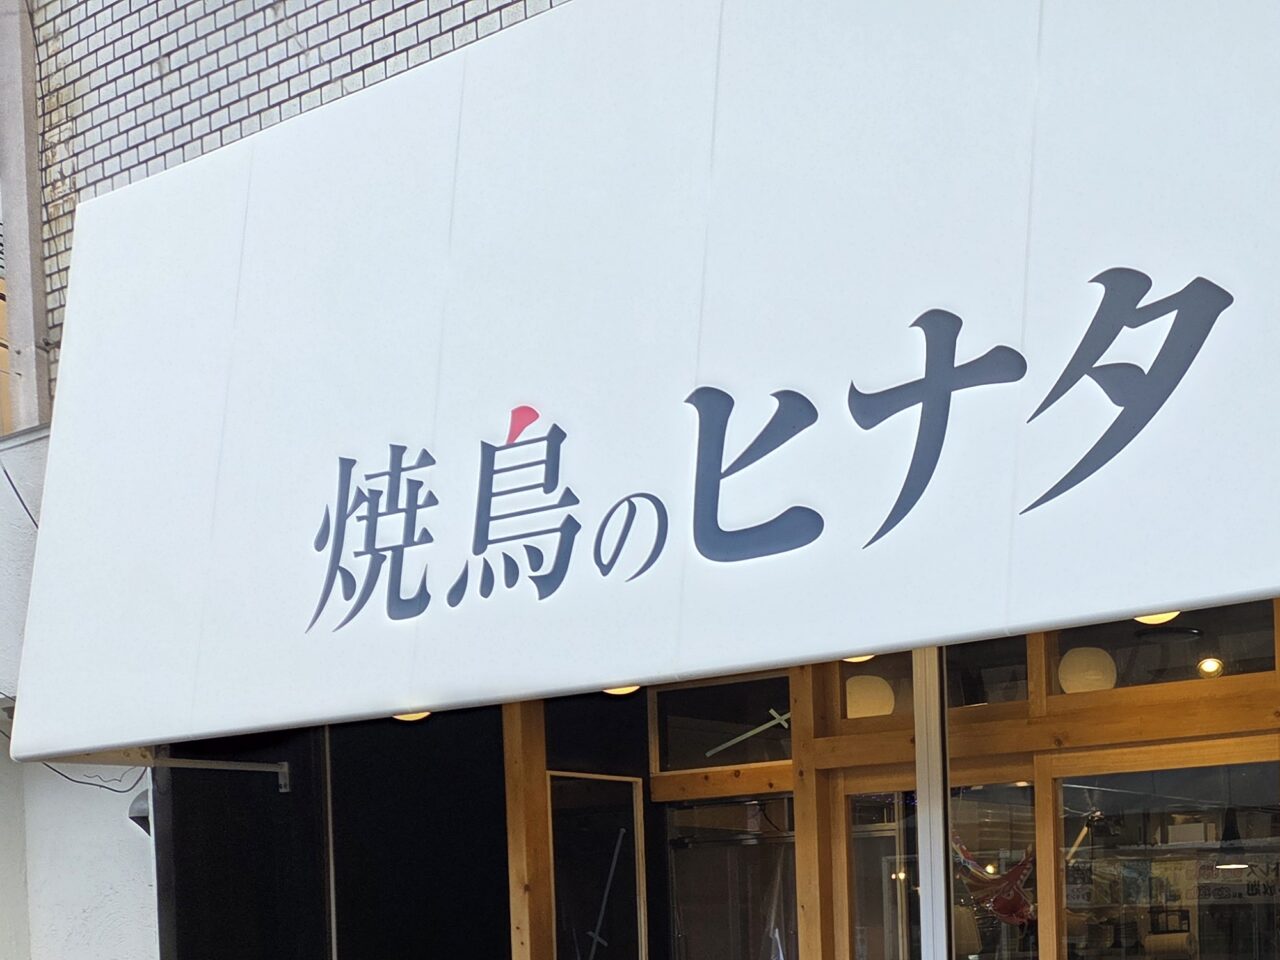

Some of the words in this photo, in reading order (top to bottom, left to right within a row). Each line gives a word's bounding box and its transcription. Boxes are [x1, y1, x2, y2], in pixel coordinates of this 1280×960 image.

[306, 267, 1235, 635] 焼鳥のヒナタ
